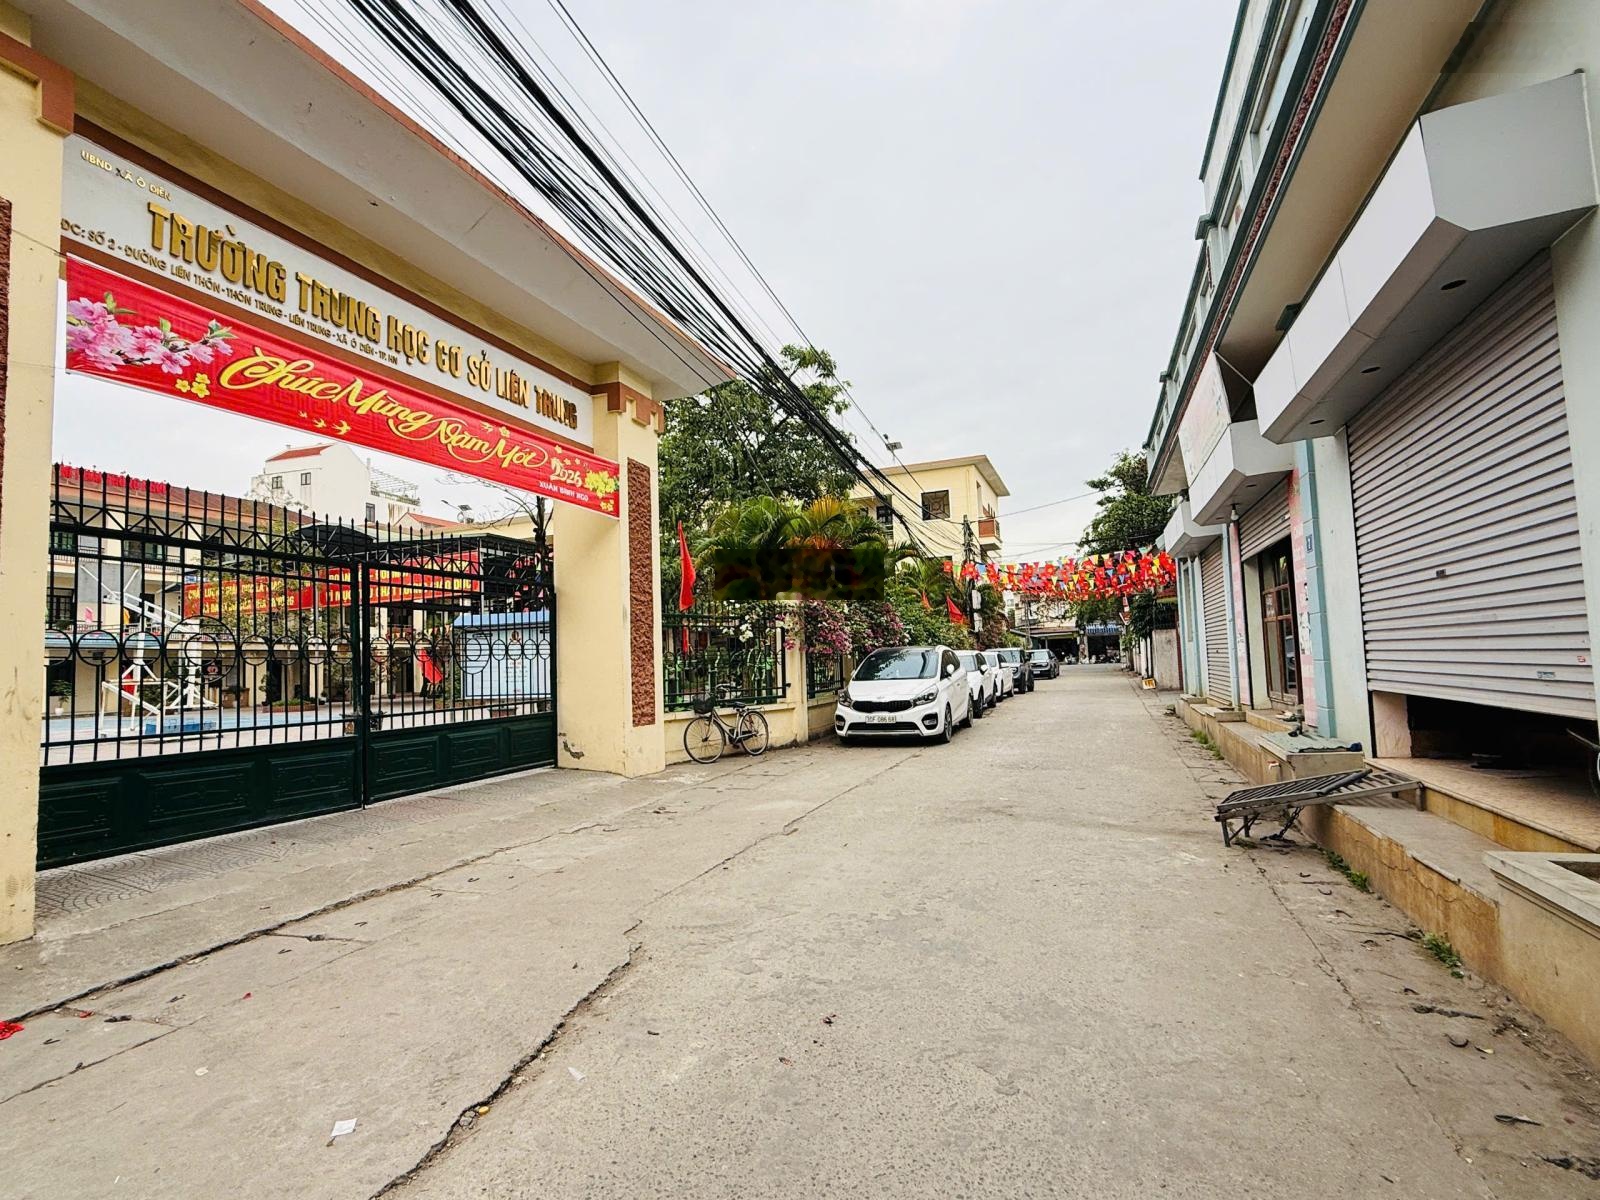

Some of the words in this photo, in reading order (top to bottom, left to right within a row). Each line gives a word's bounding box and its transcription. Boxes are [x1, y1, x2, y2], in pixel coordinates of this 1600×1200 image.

[80, 150, 113, 172] UBND
[88, 230, 106, 246] SỐ
[107, 238, 116, 251] 2
[170, 263, 191, 281] LIÊN
[193, 273, 221, 293] THÔN
[225, 287, 252, 306] THÔN
[254, 299, 283, 317] TRUNG
[289, 312, 305, 328] LIÊN
[306, 320, 332, 338] TRUNG
[336, 332, 348, 345] XÃ
[388, 354, 398, 365] HN
[147, 201, 287, 303] TRƯỜNG
[295, 271, 381, 344] TRUNG
[387, 314, 431, 365] HỌC
[435, 339, 463, 379] CƠ
[467, 350, 493, 392] SỞ
[496, 366, 530, 409] LIÊN
[534, 384, 578, 430] TRUNG
[219, 346, 337, 401] Chúc
[333, 377, 436, 441] Mừng
[491, 437, 549, 468] Mới
[550, 457, 583, 488] 2026
